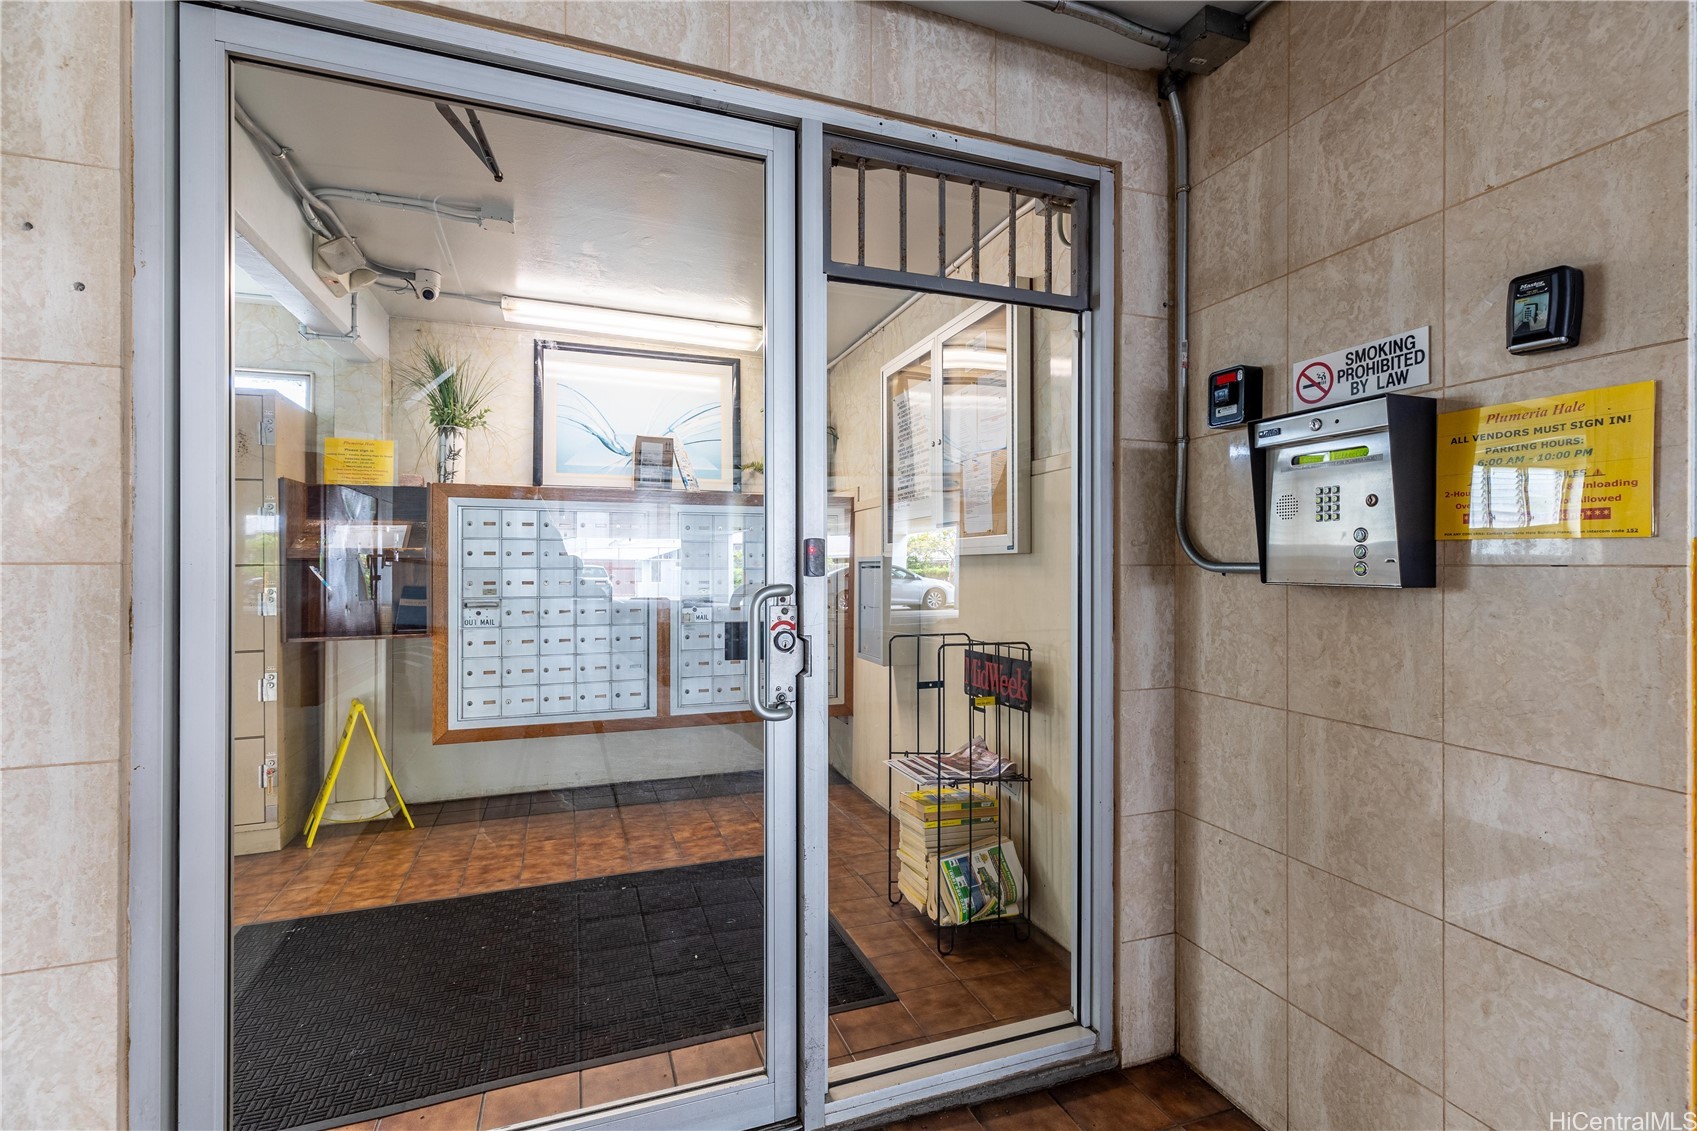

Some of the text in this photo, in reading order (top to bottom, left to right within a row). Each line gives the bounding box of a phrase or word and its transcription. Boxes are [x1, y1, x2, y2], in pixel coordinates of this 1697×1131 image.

[1345, 334, 1416, 367] SMOKING
[1337, 349, 1426, 384] PROHIBITED
[1350, 369, 1410, 396] BY LAW
[1485, 401, 1586, 425] Plumeria Hale
[1450, 414, 1632, 445] ALL VENDORS MUST SIGN IN!
[1477, 457, 1504, 468] 6:00
[1506, 455, 1525, 464] AM
[1537, 451, 1571, 462] 10:00
[1574, 448, 1594, 458] PM
[1485, 437, 1584, 455] PARKING HOURS:
